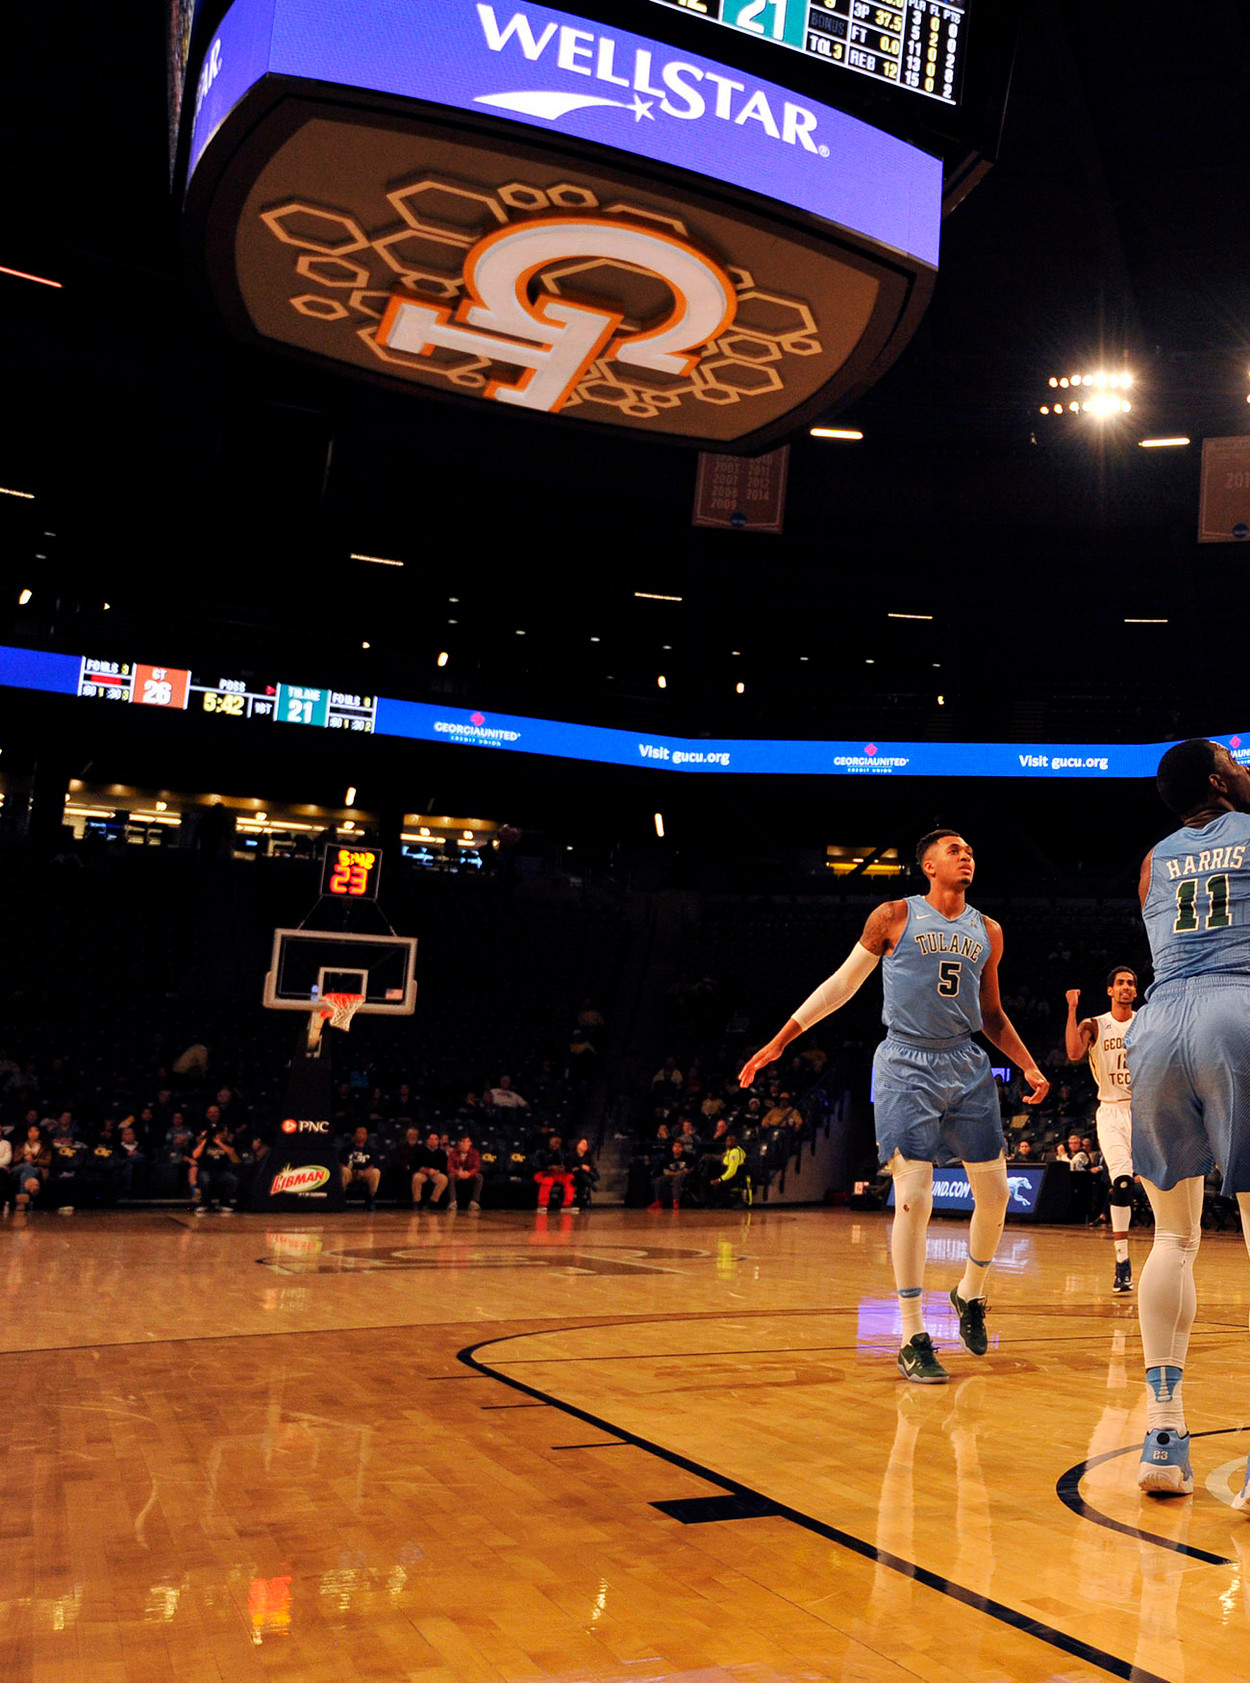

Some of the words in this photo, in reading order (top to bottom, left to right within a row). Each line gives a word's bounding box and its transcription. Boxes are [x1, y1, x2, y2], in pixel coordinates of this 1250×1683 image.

[736, 0, 788, 41] 21
[810, 11, 846, 36] BONUS
[854, 2, 870, 19] 3P
[875, 9, 902, 32] 37.5
[912, 10, 922, 25] 3
[930, 16, 940, 32] 0
[948, 23, 958, 39] 0
[930, 4, 940, 17] FL
[943, 9, 961, 24] PTS
[833, 43, 843, 60] 3
[851, 25, 868, 43] FT
[880, 35, 900, 55] 0.0
[910, 25, 921, 40] 5
[929, 32, 939, 47] 2
[947, 38, 957, 53] 0
[850, 49, 876, 72] REB
[882, 60, 898, 79] 12
[906, 55, 921, 72] 13
[926, 62, 936, 77] 0
[908, 40, 922, 57] 11
[927, 47, 938, 62] 0
[945, 53, 955, 69] 2
[477, 3, 820, 155] WELLSTAR
[904, 70, 920, 87] 15
[924, 77, 934, 93] 0
[942, 83, 953, 99] 2
[86, 658, 119, 674] FOULS
[142, 679, 172, 705] 26
[219, 677, 246, 693] POSS
[203, 691, 245, 716] 5:42
[286, 699, 313, 724] 21
[332, 691, 361, 707] FOULS
[638, 743, 670, 761] Visit
[672, 750, 730, 766] gucu.org
[1019, 754, 1048, 768] Visit
[1051, 755, 1108, 770] gucu.org
[1166, 845, 1247, 880] HARRIS
[329, 864, 369, 895] 23
[1173, 873, 1233, 934] 11
[914, 931, 984, 963] TULANE
[937, 960, 962, 998] 5
[1103, 1037, 1126, 1052] GEO
[298, 1120, 330, 1133] PNC
[270, 1169, 326, 1195] LIBMAN
[1153, 1450, 1169, 1461] 23
